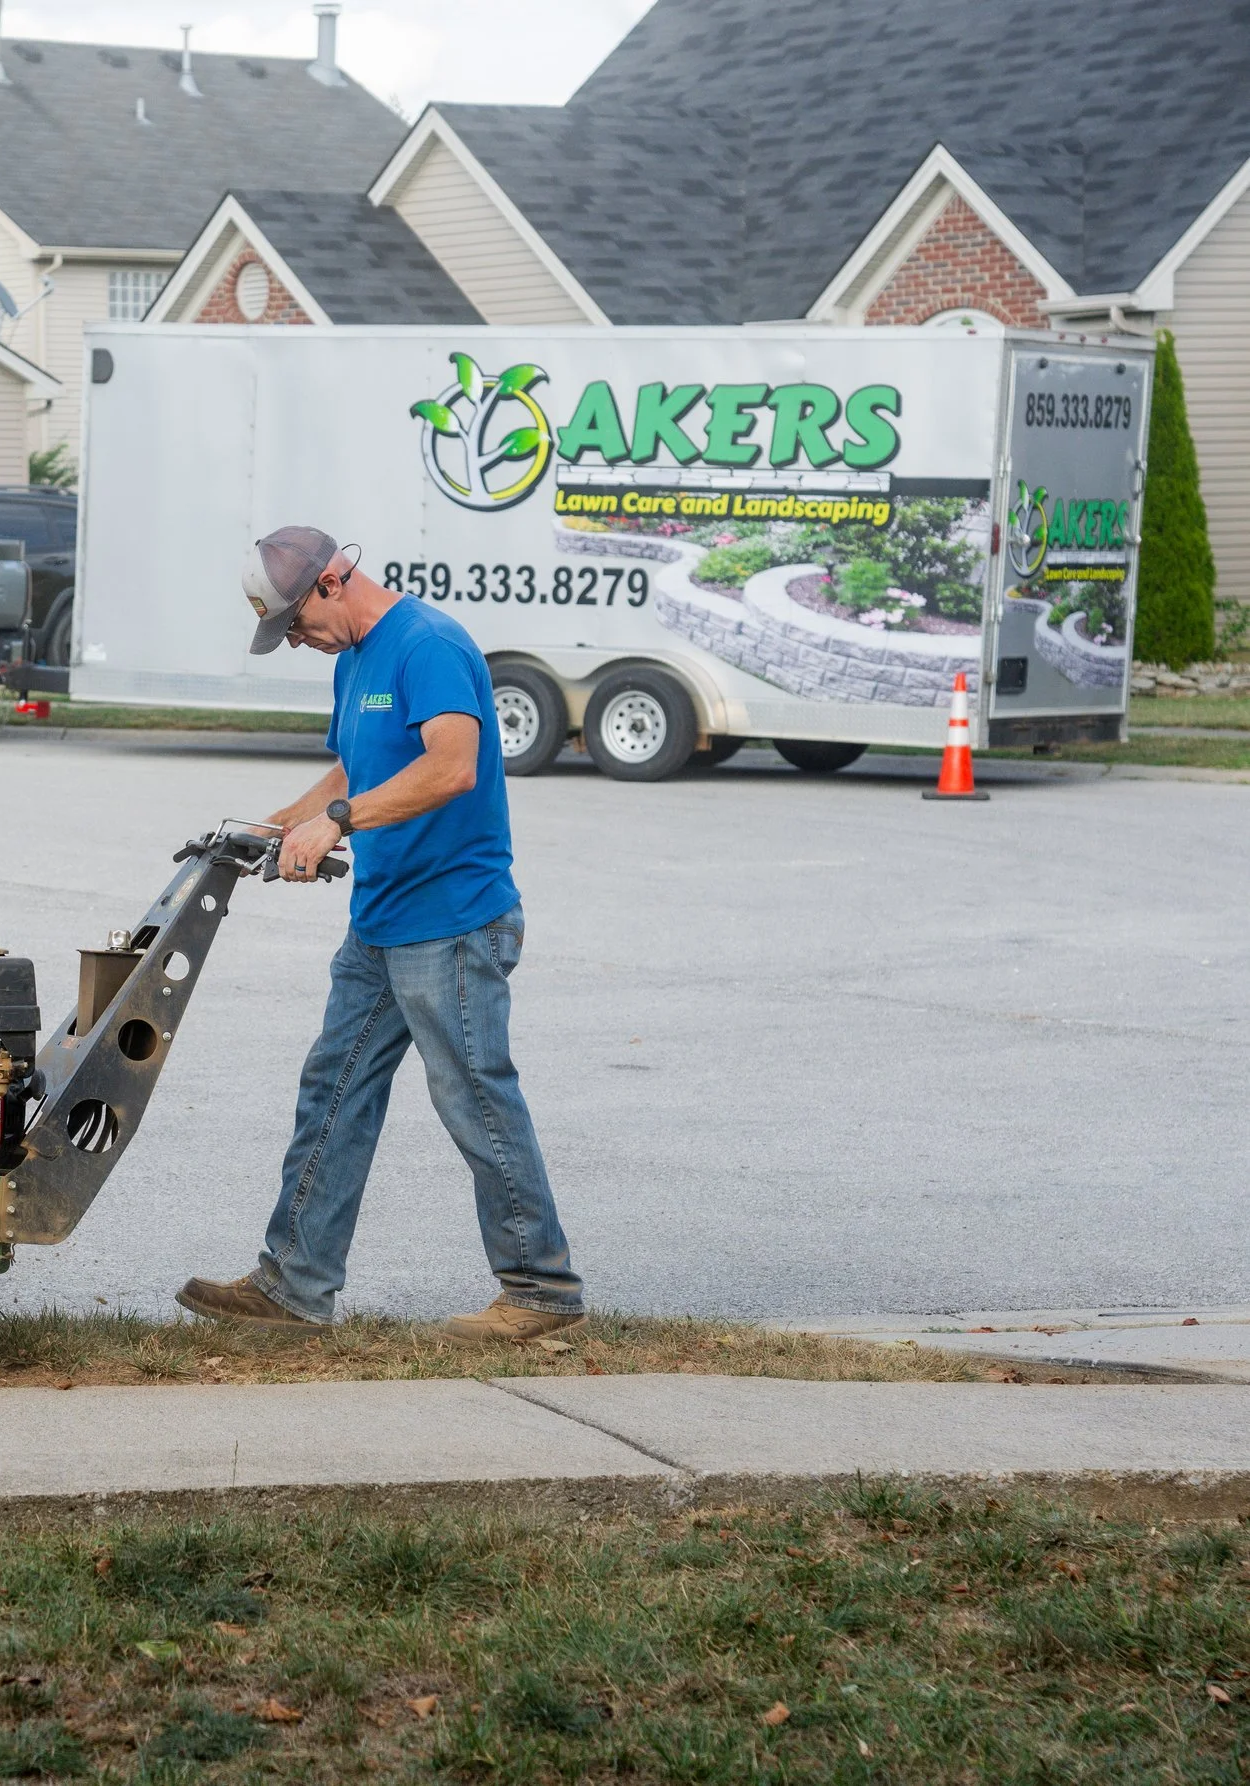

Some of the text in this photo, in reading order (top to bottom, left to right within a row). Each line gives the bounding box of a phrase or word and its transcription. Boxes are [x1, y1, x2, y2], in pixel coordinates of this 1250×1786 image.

[556, 380, 902, 469] AKERS
[1025, 392, 1132, 430] 859.333.8279
[555, 490, 891, 527] Lawn Care and Landscaping
[1047, 497, 1129, 549] AKERS
[383, 562, 650, 608] 859.333.8279
